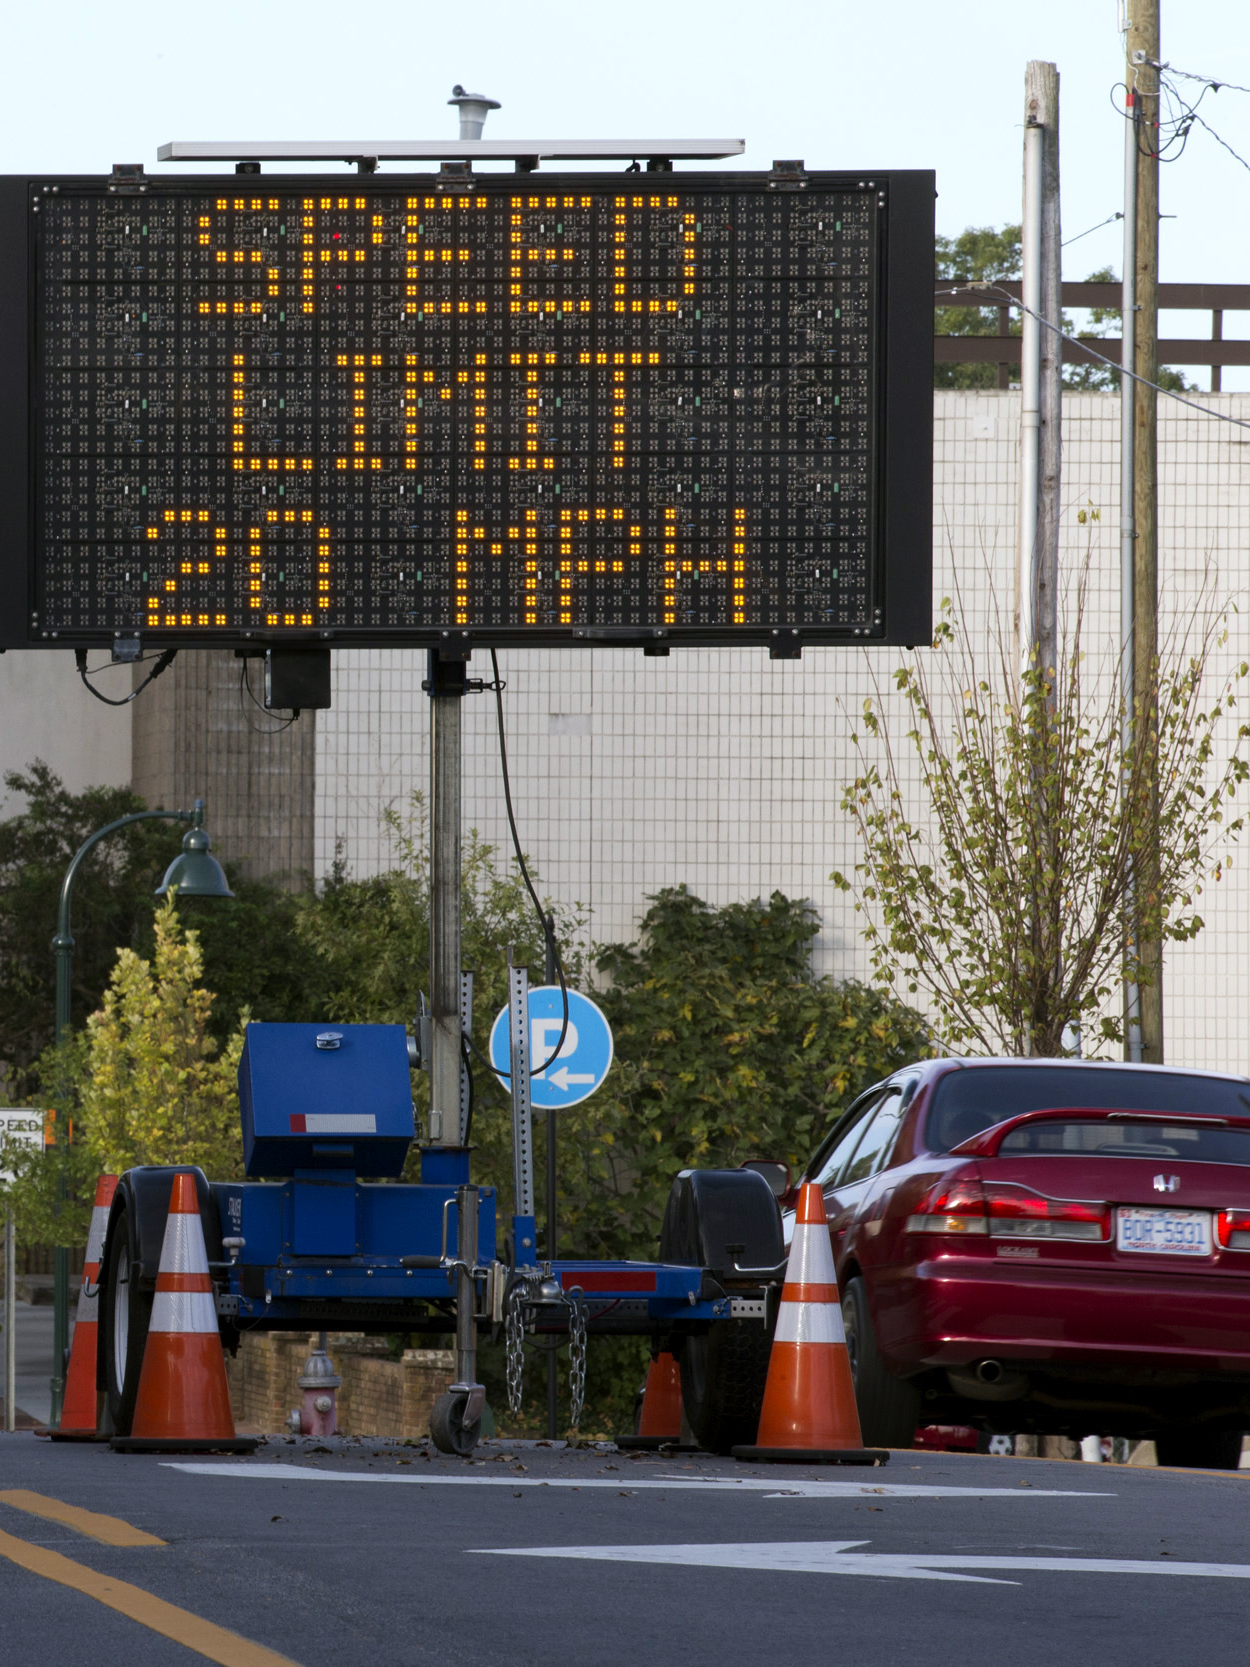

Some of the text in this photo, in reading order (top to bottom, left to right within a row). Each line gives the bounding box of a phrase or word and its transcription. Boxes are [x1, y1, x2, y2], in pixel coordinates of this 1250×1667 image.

[199, 196, 696, 314] SPEED
[233, 352, 660, 470] LIMIT
[147, 508, 746, 626] 20 MPH
